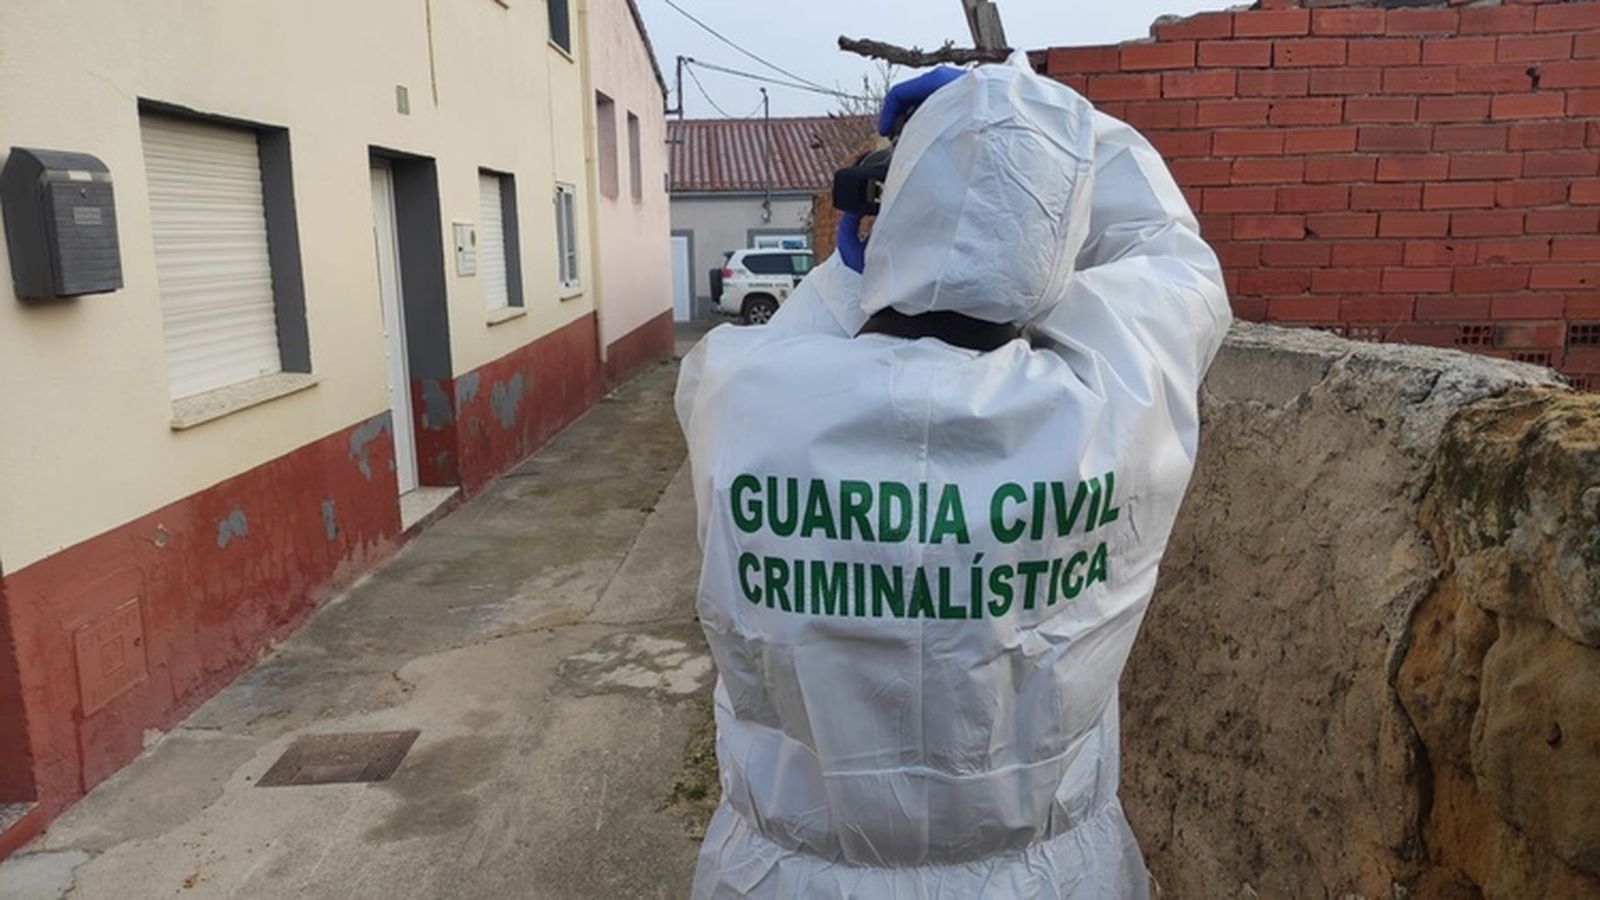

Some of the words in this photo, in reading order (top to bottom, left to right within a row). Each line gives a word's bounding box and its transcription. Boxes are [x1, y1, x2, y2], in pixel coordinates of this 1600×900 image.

[730, 473, 970, 545] GUARDIA
[989, 471, 1119, 545] CIVIL
[738, 542, 1108, 620] CRIMINALÍSTICA
